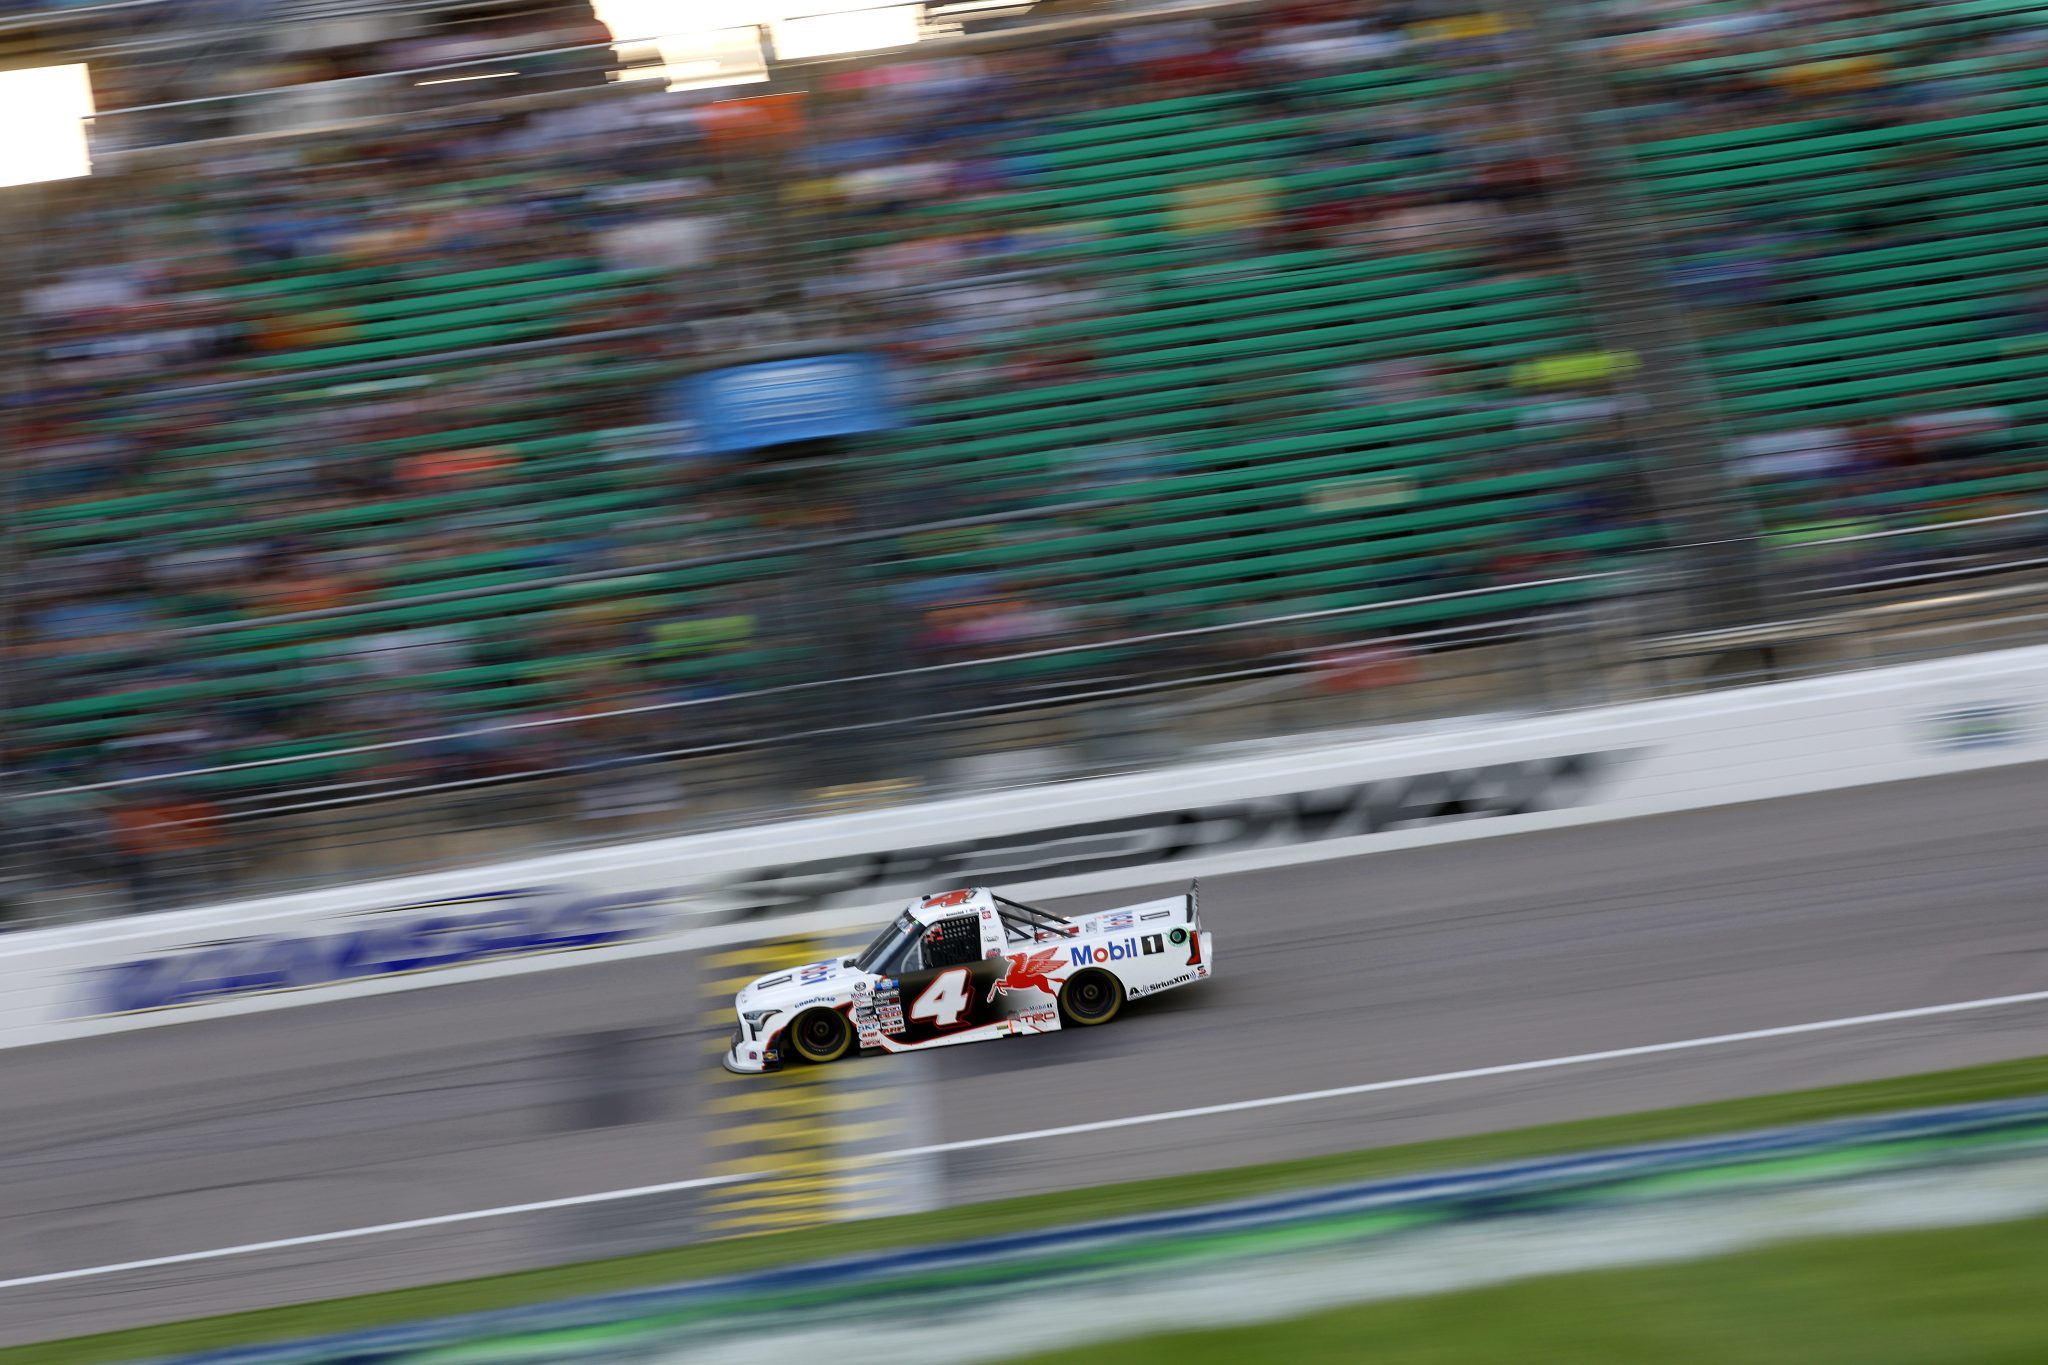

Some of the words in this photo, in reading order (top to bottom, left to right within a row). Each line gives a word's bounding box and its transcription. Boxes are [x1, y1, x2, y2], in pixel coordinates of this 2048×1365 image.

[1070, 937, 1138, 967] Mobil
[1143, 934, 1161, 954] 1
[794, 996, 836, 1008] GOODYEAR
[909, 967, 974, 1028] 4
[1021, 1011, 1056, 1024] TRD
